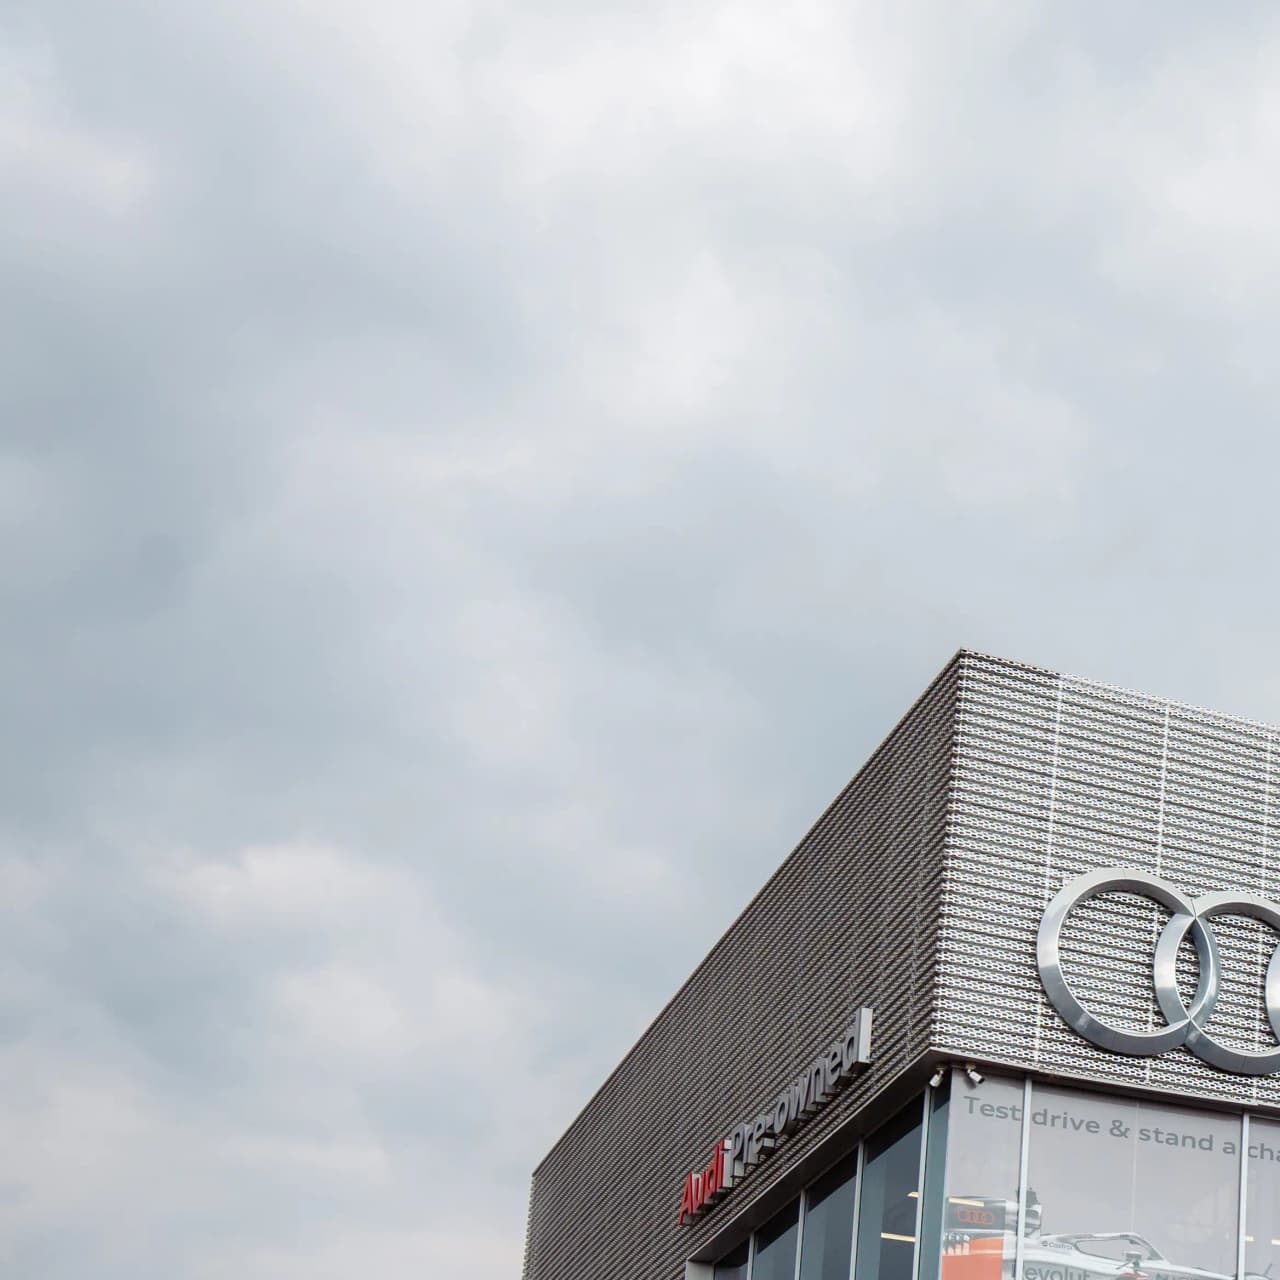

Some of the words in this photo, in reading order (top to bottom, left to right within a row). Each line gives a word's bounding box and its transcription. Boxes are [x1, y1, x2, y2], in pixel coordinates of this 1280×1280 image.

[677, 1137, 733, 1225] Audi
[731, 1007, 873, 1177] Pre-owned
[963, 1095, 1023, 1122] Test
[1031, 1108, 1100, 1133] drive
[1109, 1119, 1130, 1139] &
[1138, 1127, 1213, 1152] stand
[1222, 1141, 1236, 1155] a
